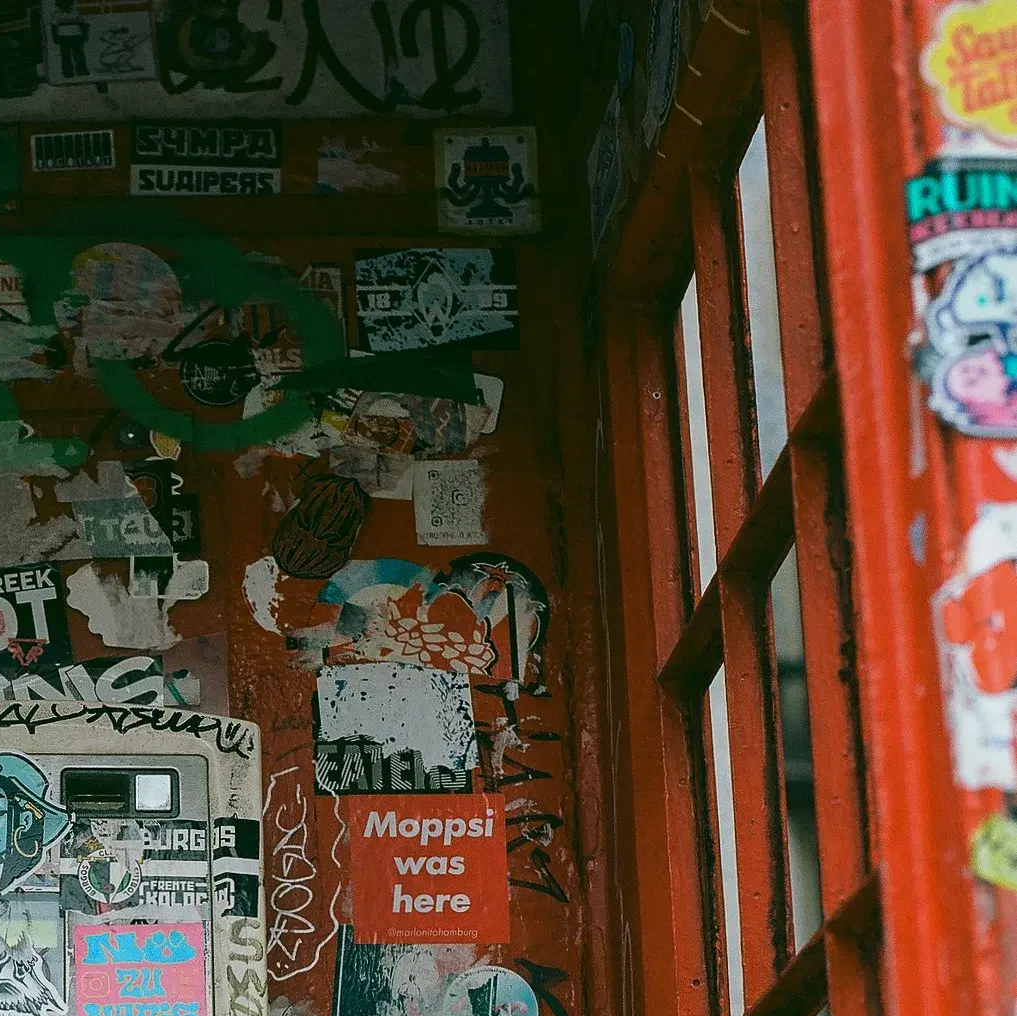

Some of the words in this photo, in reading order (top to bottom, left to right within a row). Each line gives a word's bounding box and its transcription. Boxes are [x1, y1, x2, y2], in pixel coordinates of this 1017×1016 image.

[362, 809, 494, 846] Moppsi
[393, 855, 466, 876] was
[149, 880, 195, 892] FRENTE
[391, 884, 471, 914] here
[114, 967, 166, 999] ZU
